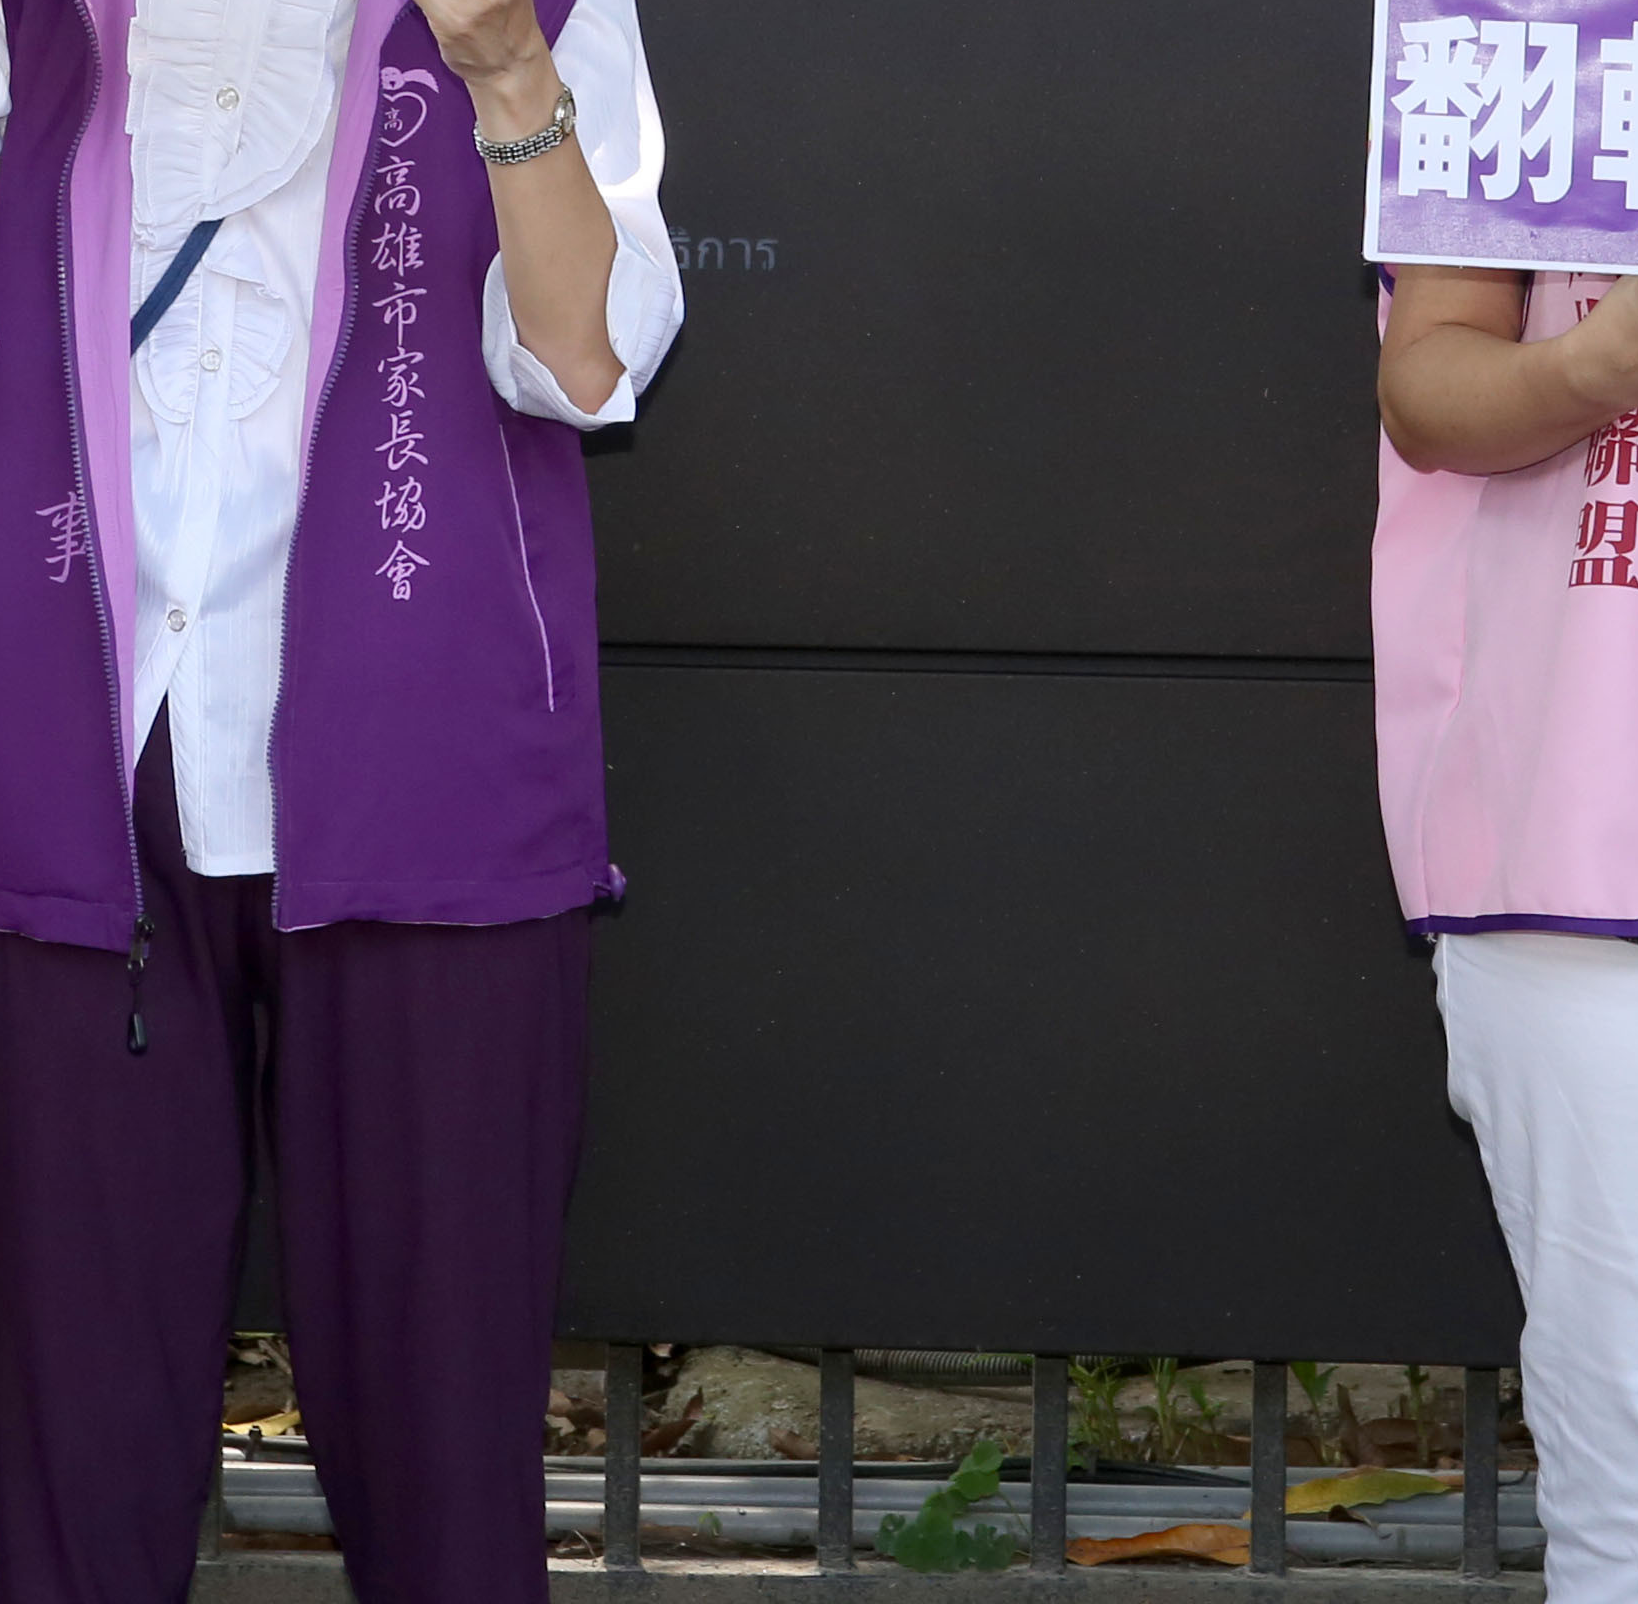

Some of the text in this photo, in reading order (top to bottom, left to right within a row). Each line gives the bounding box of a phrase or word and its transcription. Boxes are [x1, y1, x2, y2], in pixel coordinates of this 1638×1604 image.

[371, 155, 430, 601] 高雄市家長協會
